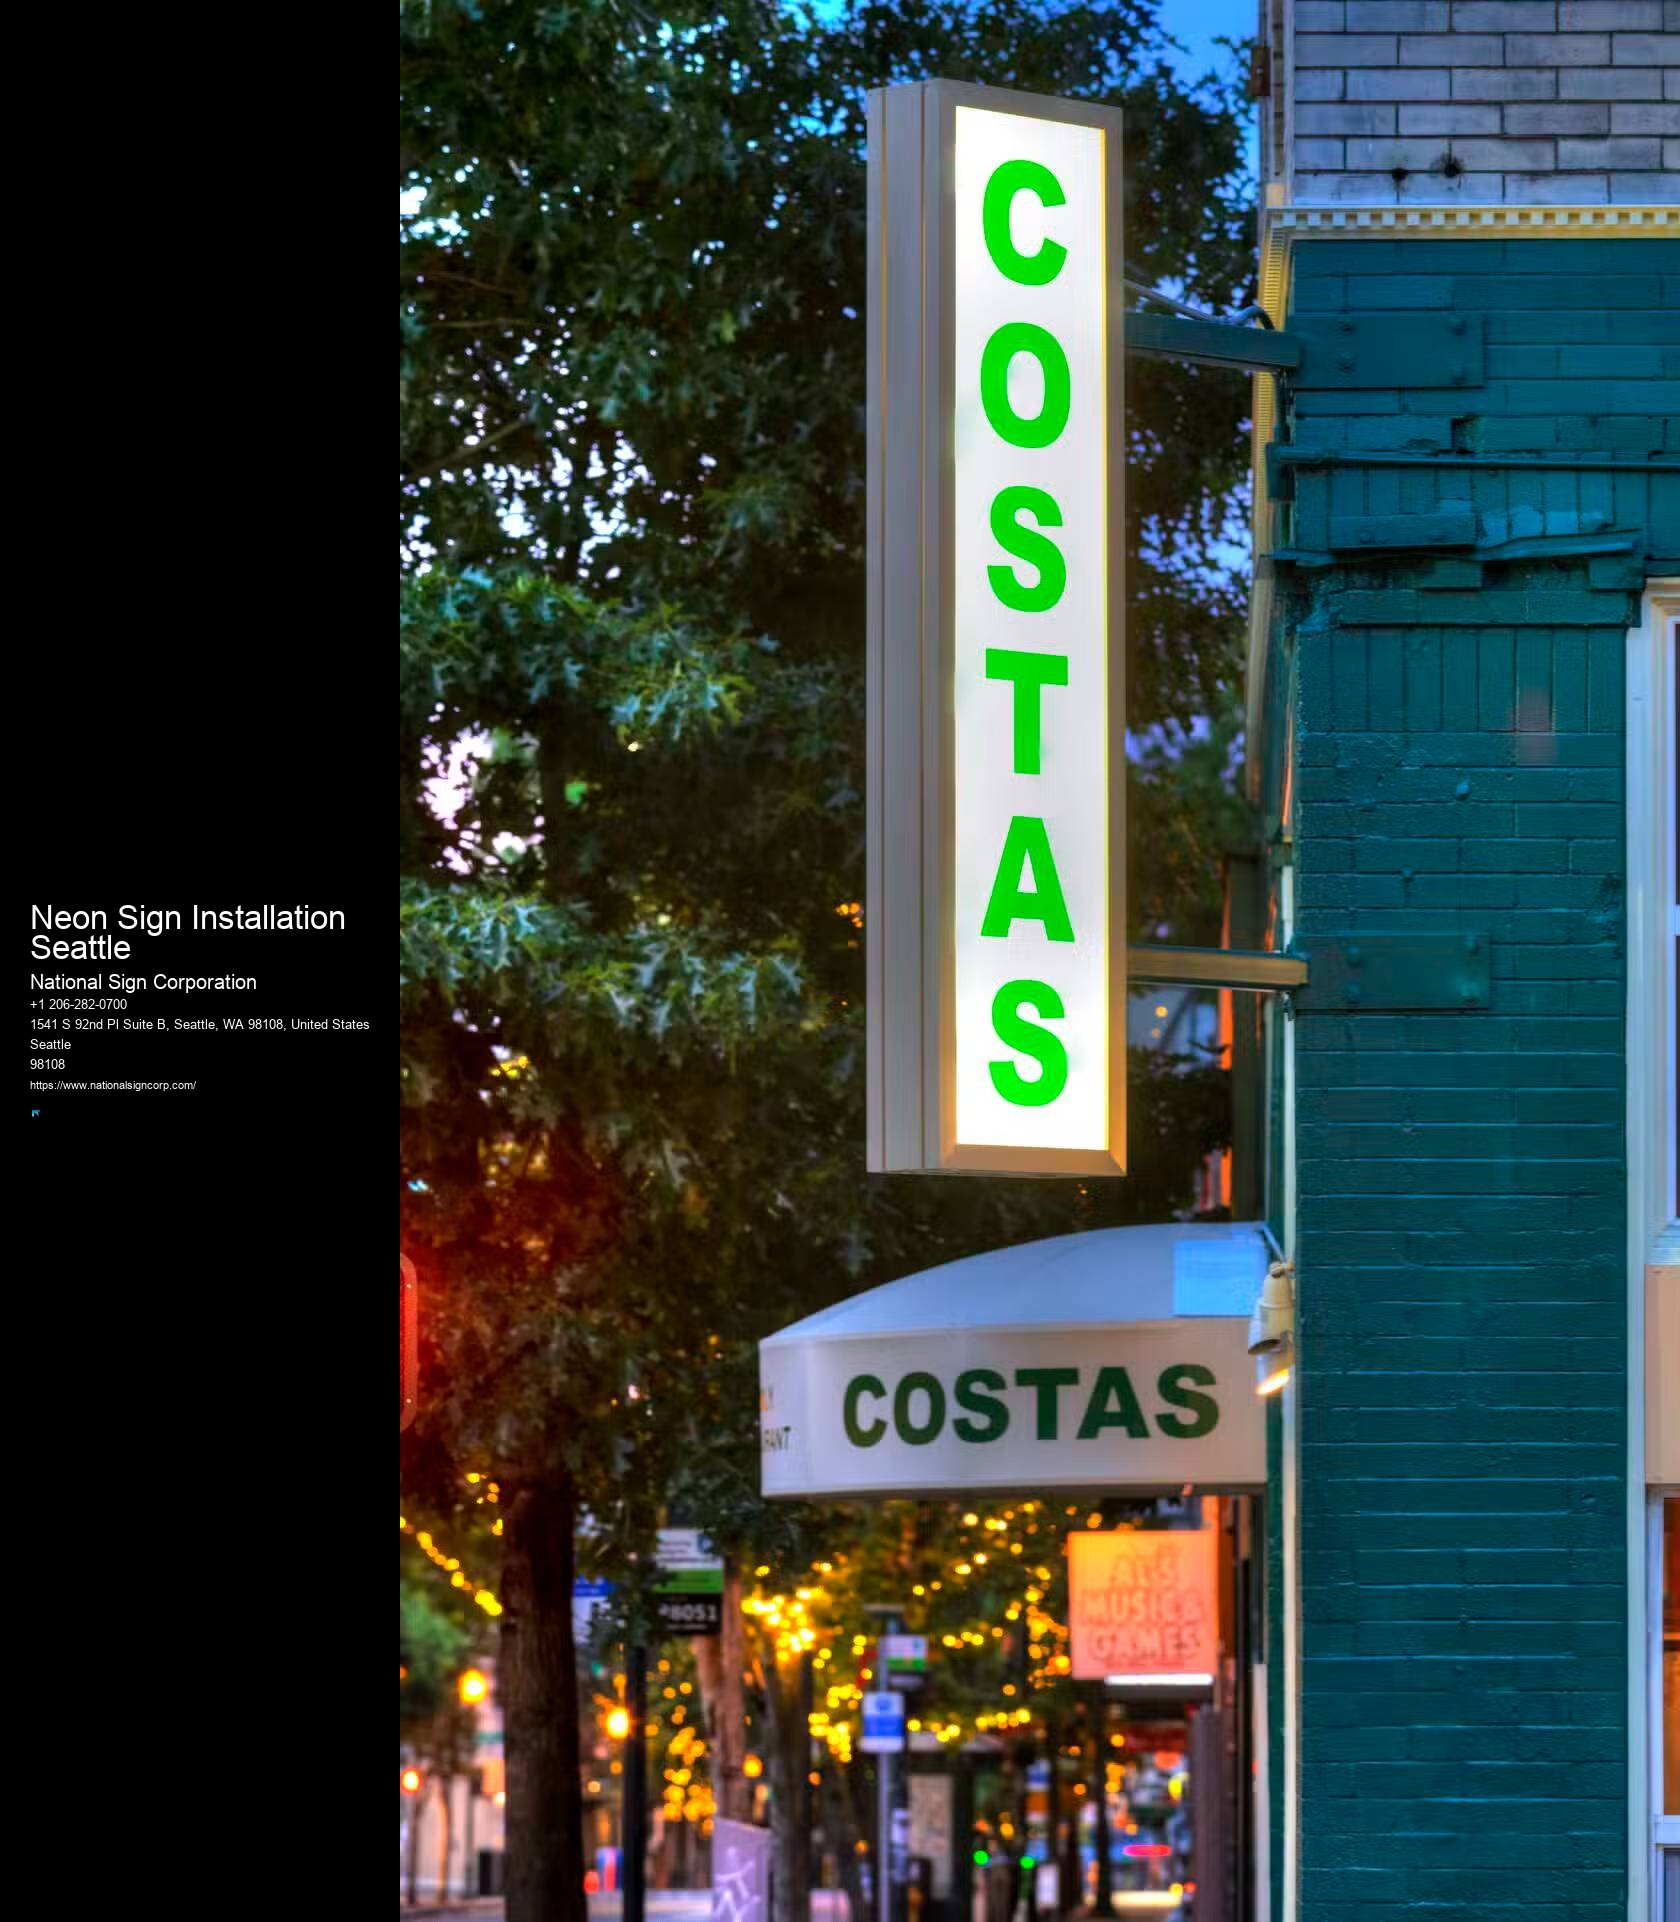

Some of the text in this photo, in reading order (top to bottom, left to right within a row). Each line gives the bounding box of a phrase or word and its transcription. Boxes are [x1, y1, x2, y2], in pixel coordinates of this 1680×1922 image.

[979, 159, 1075, 1106] COSTAS
[843, 1363, 1220, 1448] COSTAS
[1083, 1589, 1177, 1625] MUSIC
[1089, 1624, 1200, 1659] GAMES
